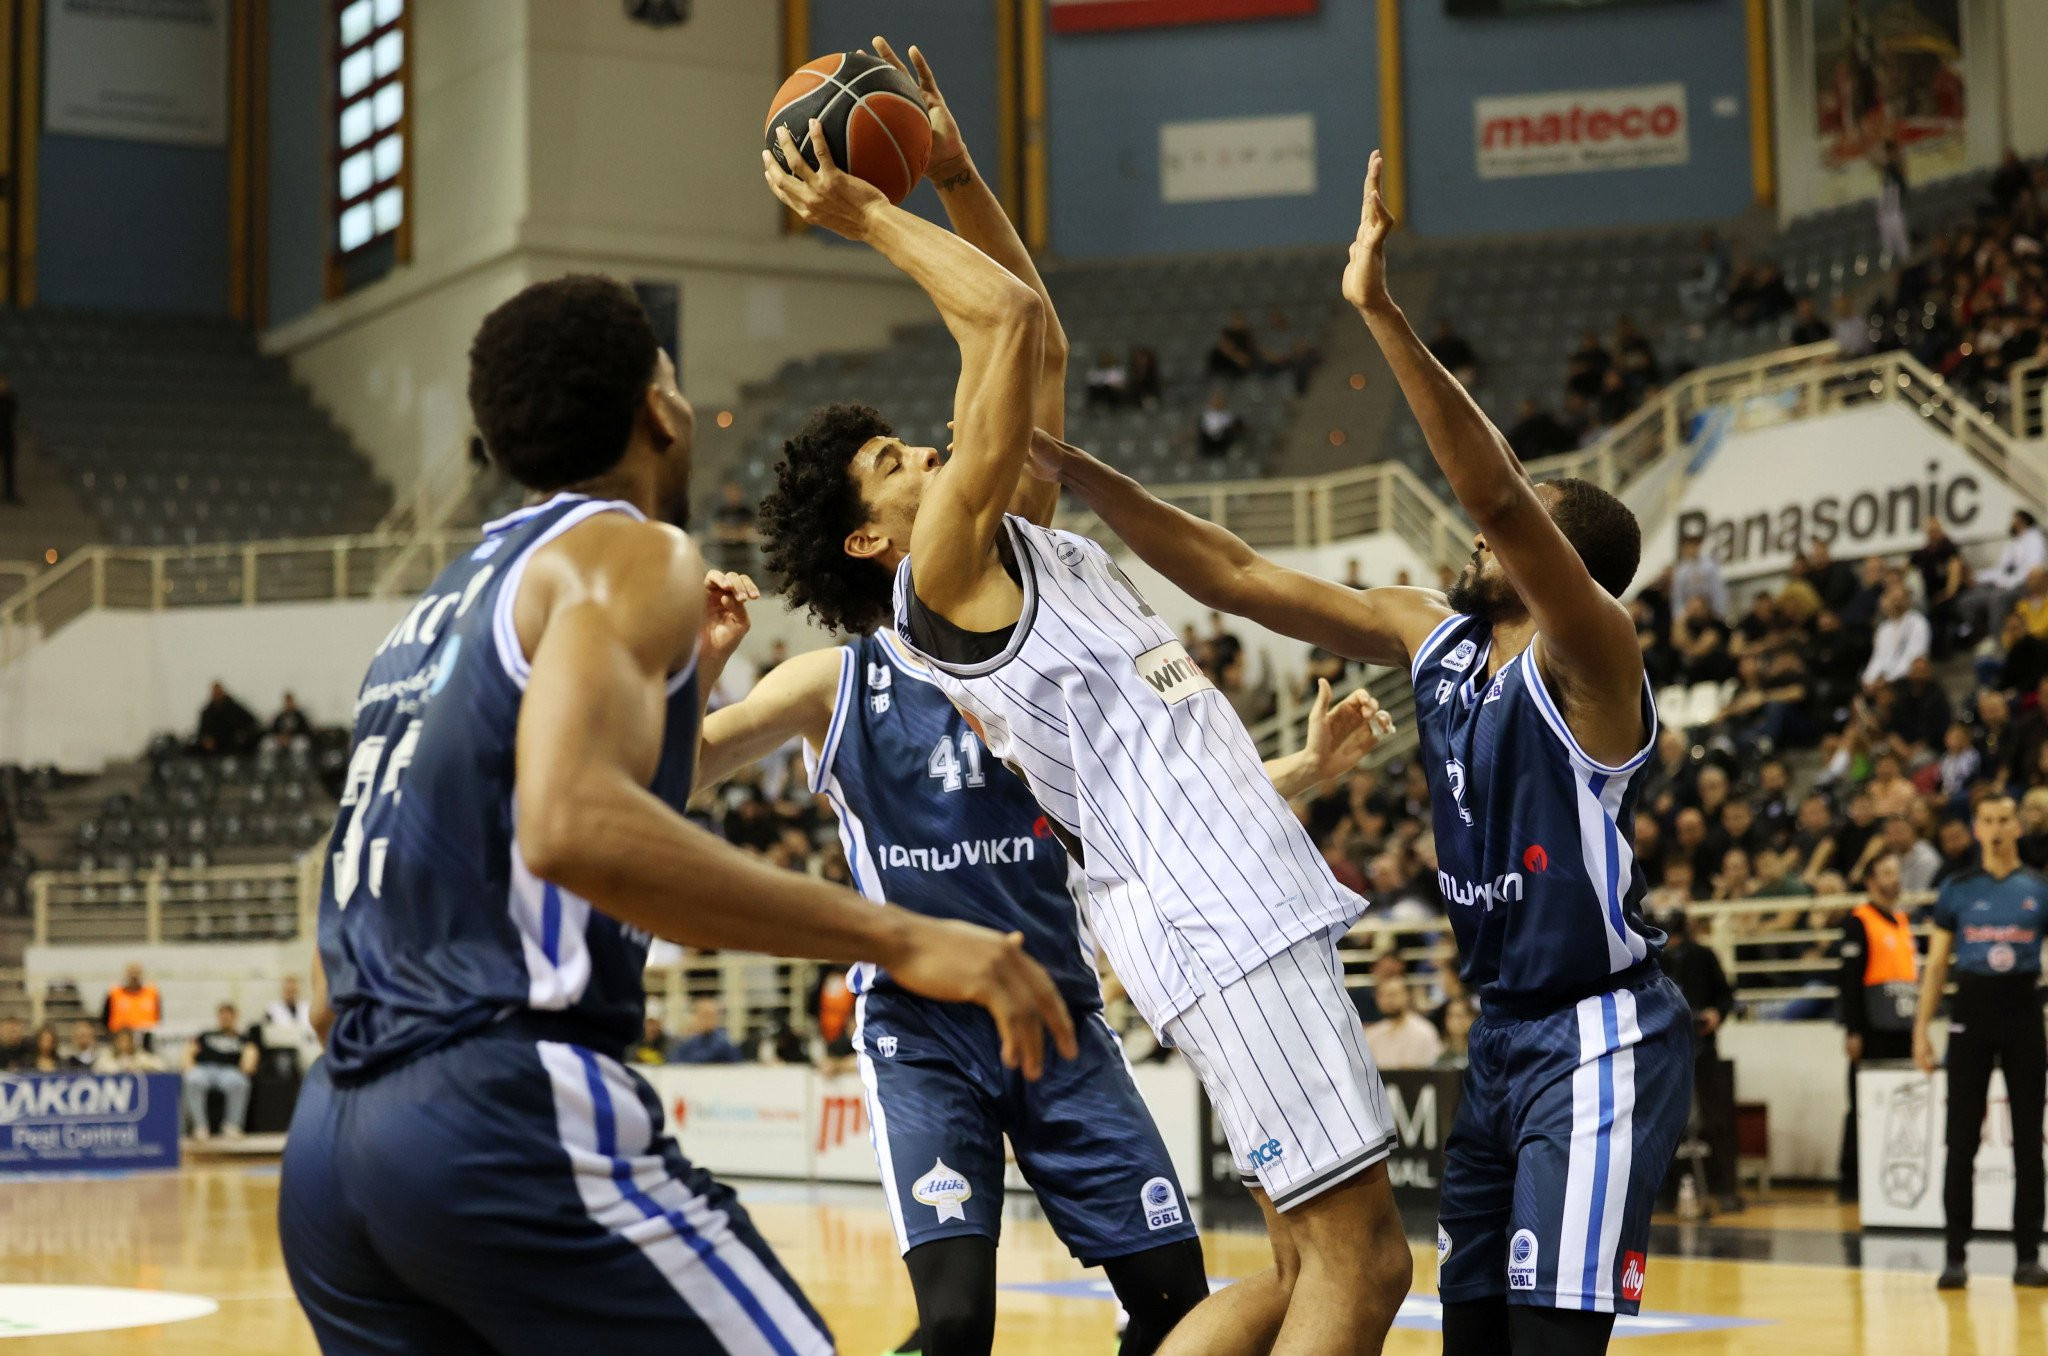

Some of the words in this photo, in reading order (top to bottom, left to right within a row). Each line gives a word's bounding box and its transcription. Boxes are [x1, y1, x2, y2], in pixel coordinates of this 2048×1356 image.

[1483, 102, 1679, 150] mateco
[1677, 459, 1979, 563] Panasonic
[928, 731, 986, 793] 41
[62, 1123, 139, 1150] Control
[919, 1179, 966, 1195] Attiki
[1151, 1211, 1180, 1226] GBL
[1511, 1275, 1533, 1286] GBL
[1622, 1259, 1644, 1297] illy
